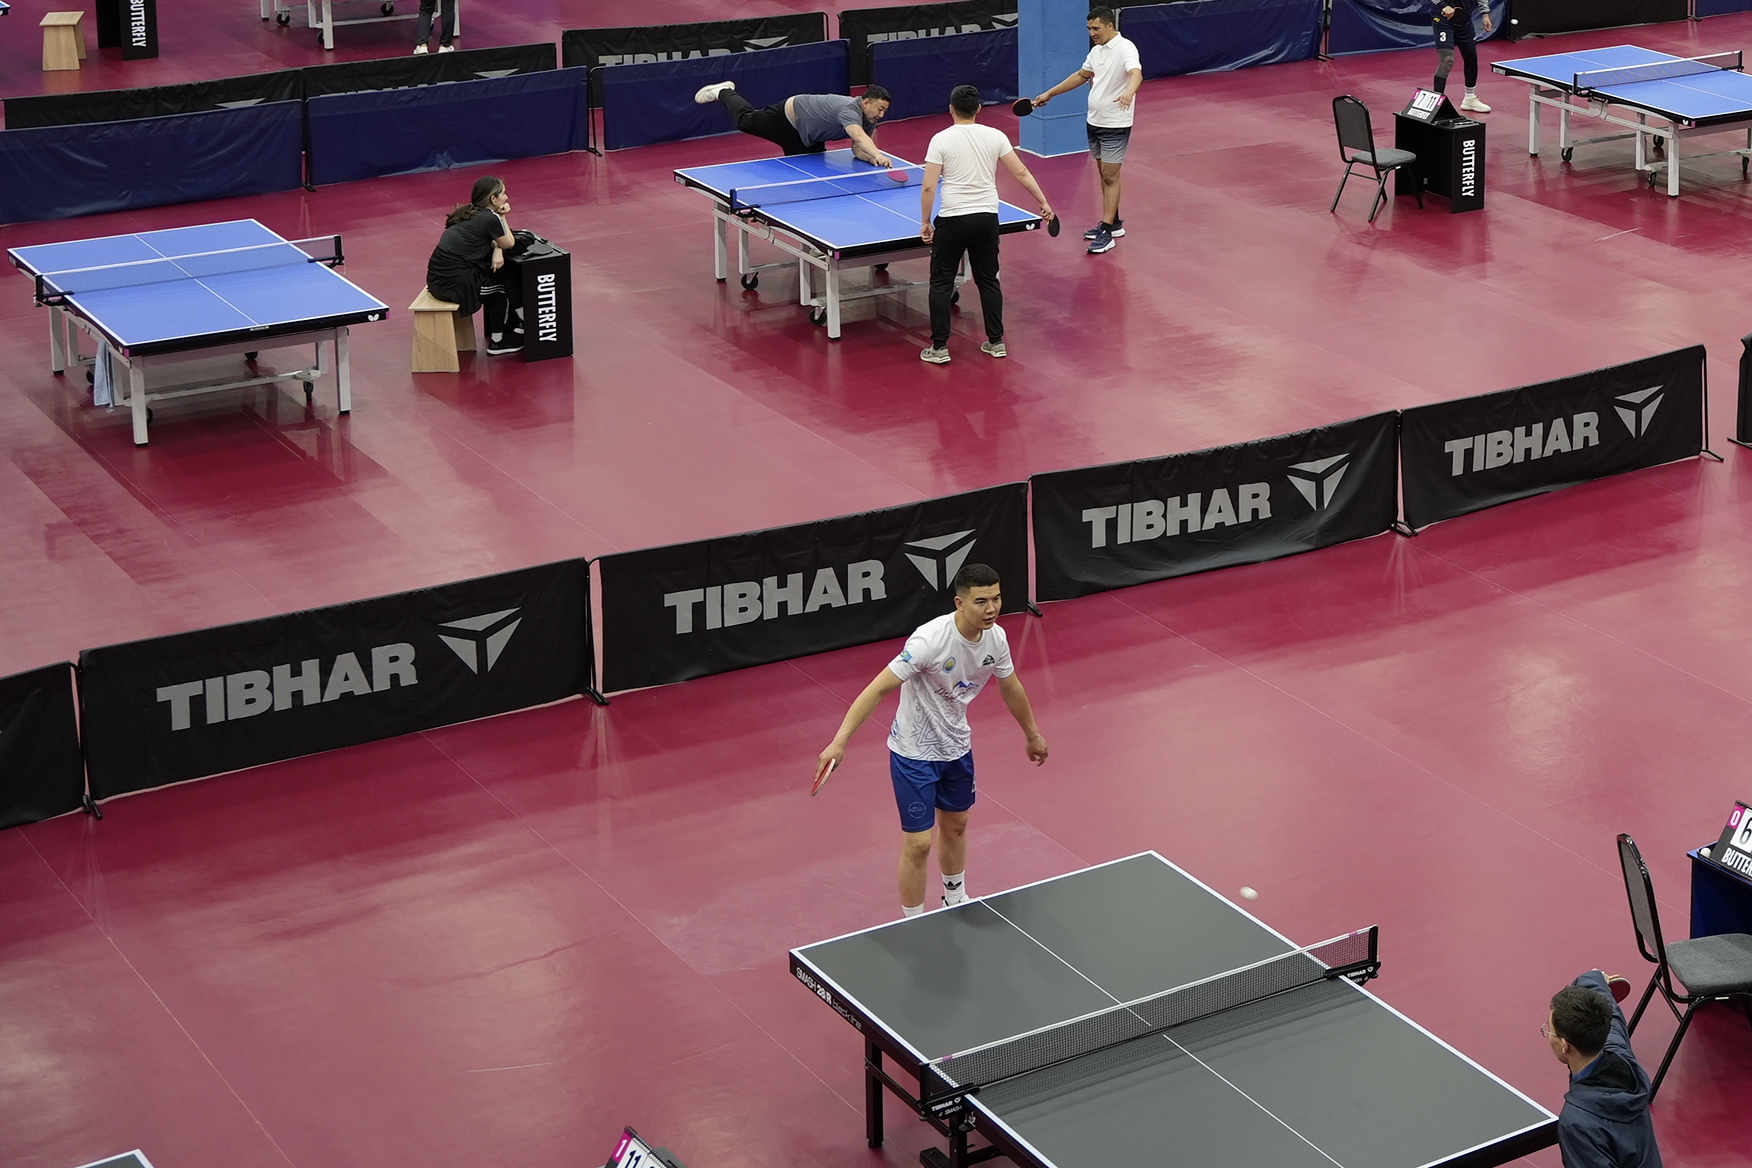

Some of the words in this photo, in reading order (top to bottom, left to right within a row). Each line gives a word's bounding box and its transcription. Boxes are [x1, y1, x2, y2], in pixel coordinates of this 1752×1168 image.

[1440, 32, 1446, 42] 3
[1461, 139, 1476, 198] BUTTERFLY
[537, 274, 557, 341] BUTTERFLY
[1445, 410, 1600, 477] TIBHAR
[1082, 481, 1272, 549] TIBHAR
[664, 560, 886, 635] TIBHAR
[156, 642, 419, 731] TIBHAR
[1730, 810, 1741, 827] 0
[796, 966, 817, 992] SMASH
[931, 1100, 953, 1112] TIBHAR
[616, 1139, 628, 1158] 1
[624, 1149, 642, 1168] 11
